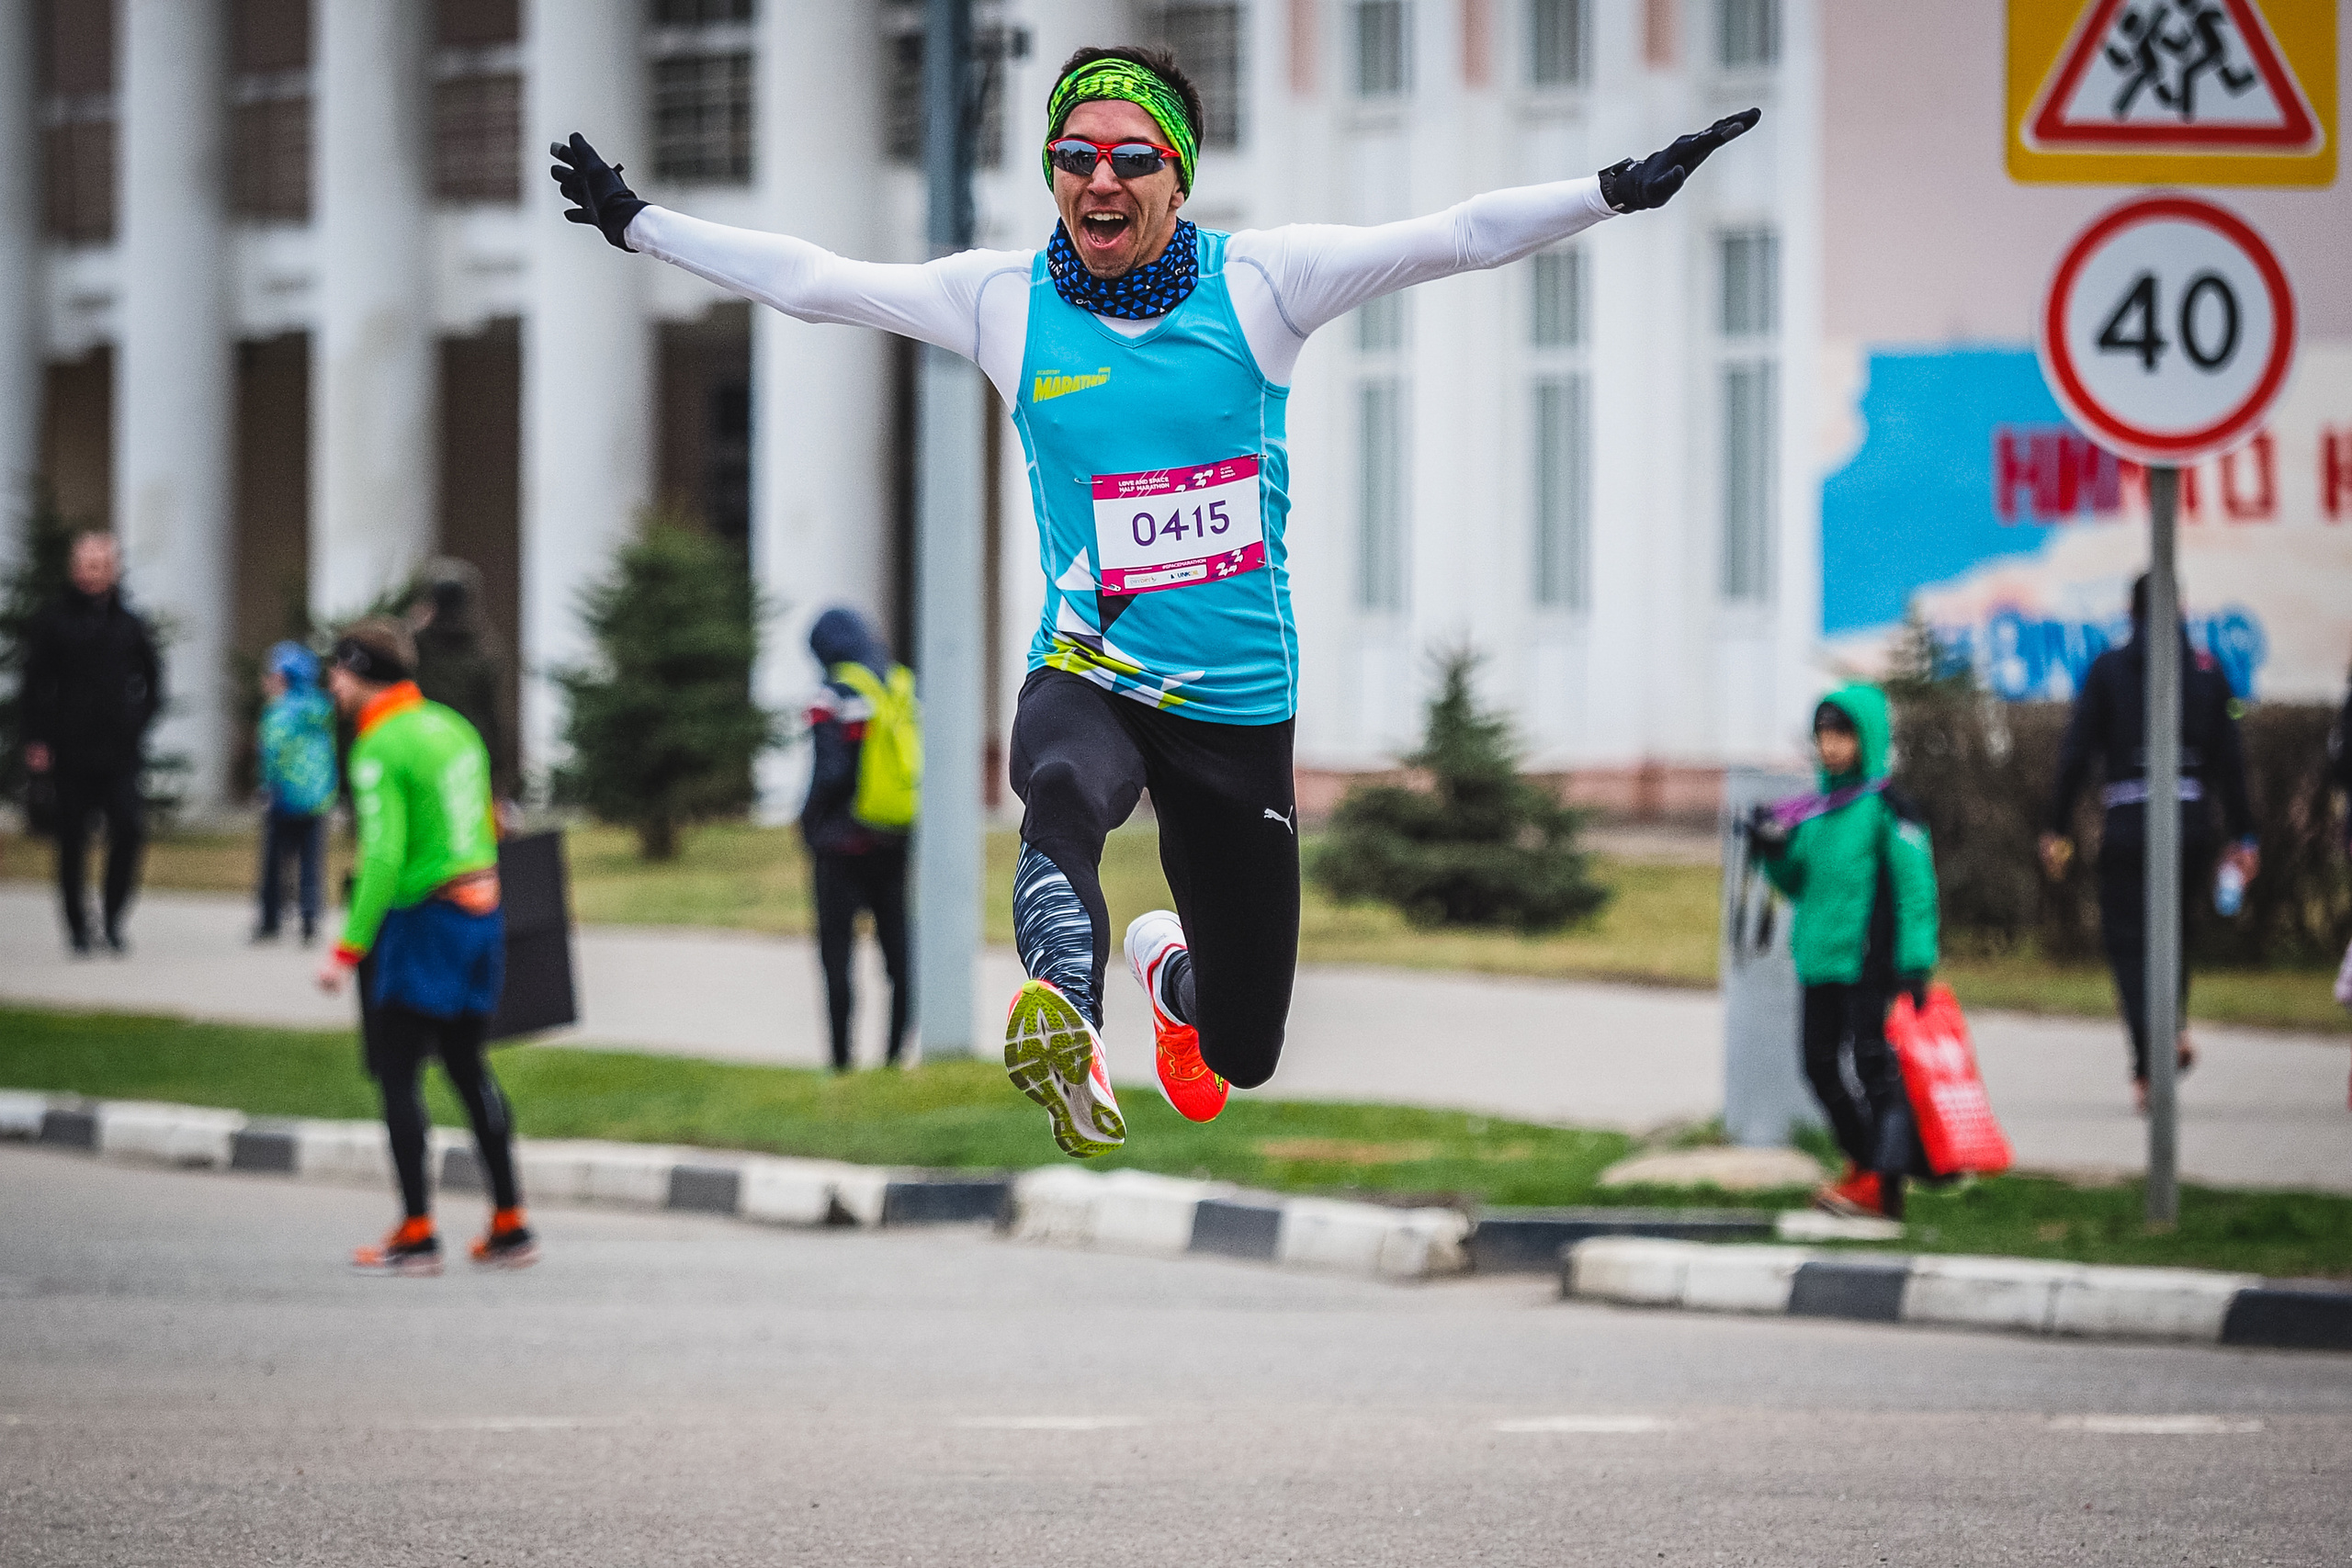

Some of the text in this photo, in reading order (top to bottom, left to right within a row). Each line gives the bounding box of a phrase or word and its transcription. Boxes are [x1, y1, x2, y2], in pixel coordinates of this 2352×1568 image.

[2097, 271, 2243, 372] 40
[1136, 483, 1170, 491] MARATHON
[1132, 500, 1230, 547] 0415
